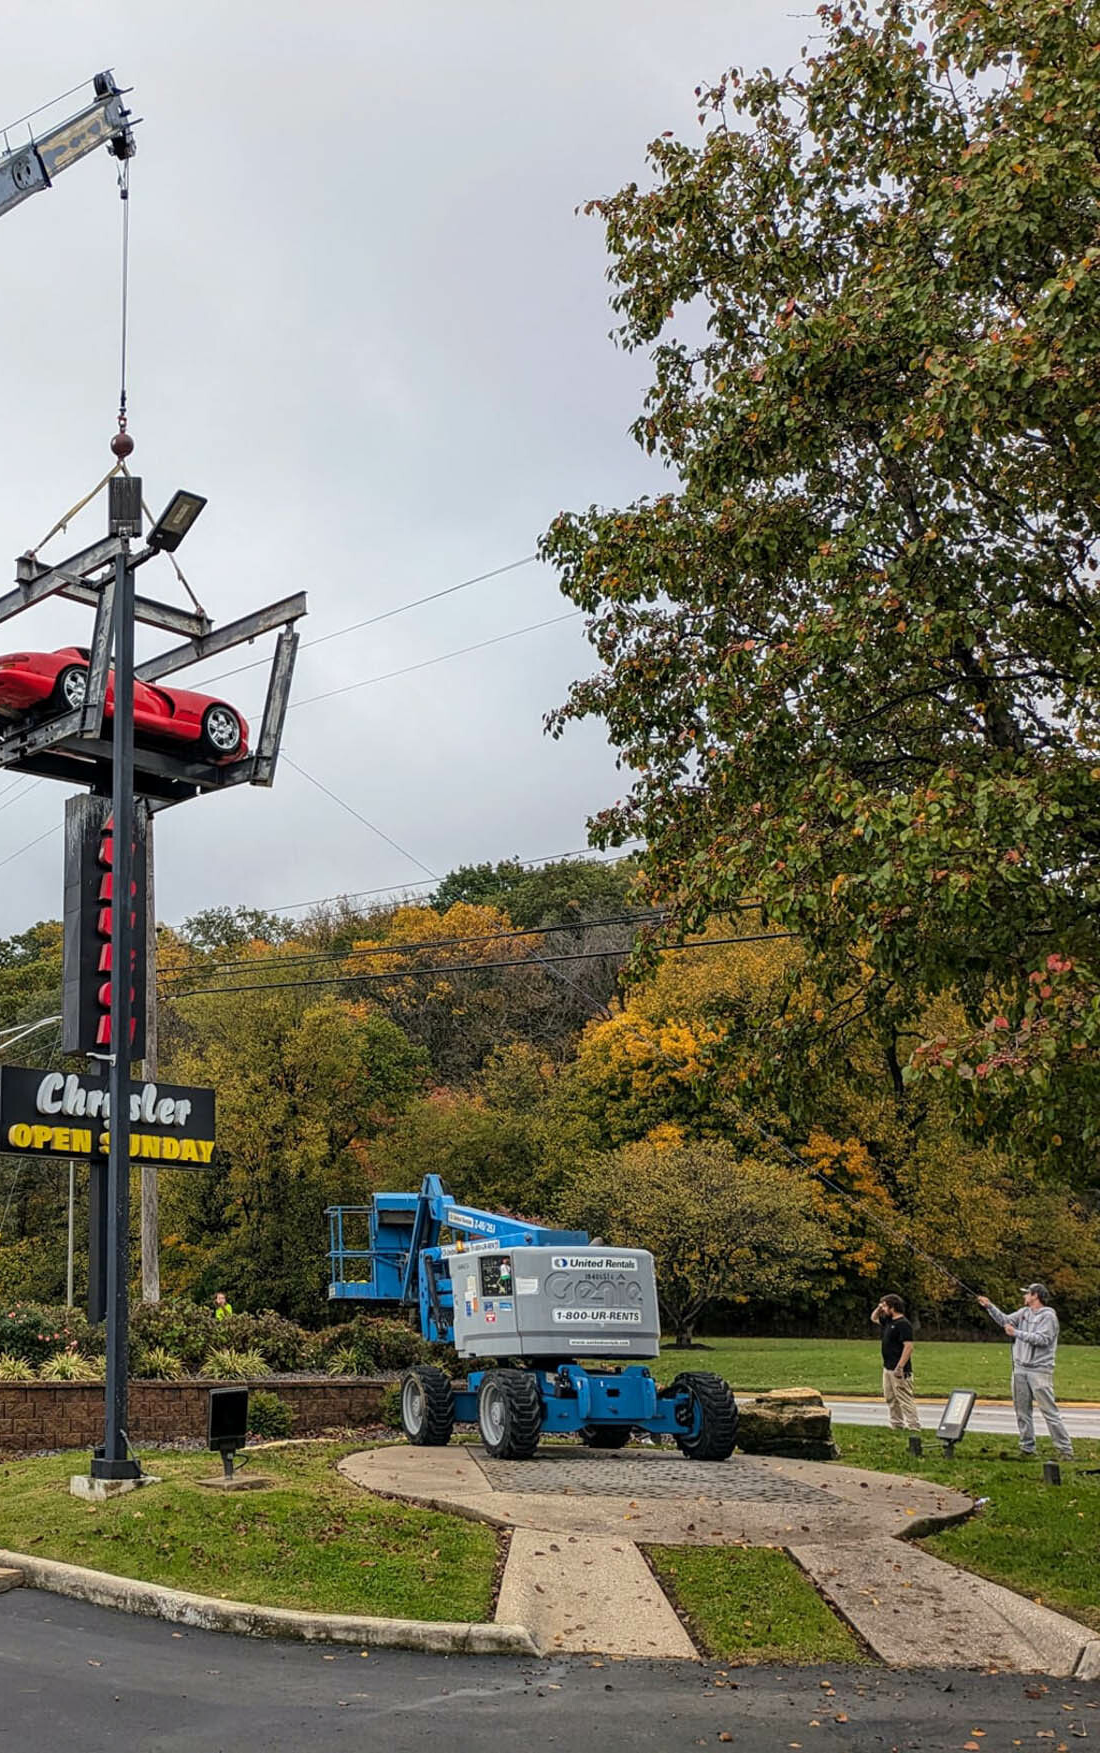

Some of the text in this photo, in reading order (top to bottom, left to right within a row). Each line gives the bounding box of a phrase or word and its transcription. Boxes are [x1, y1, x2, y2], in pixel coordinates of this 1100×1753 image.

[8, 1123, 92, 1153] OPEN
[570, 1259, 635, 1269] United Rentals
[556, 1311, 640, 1321] 1-800-UR-RENTS
